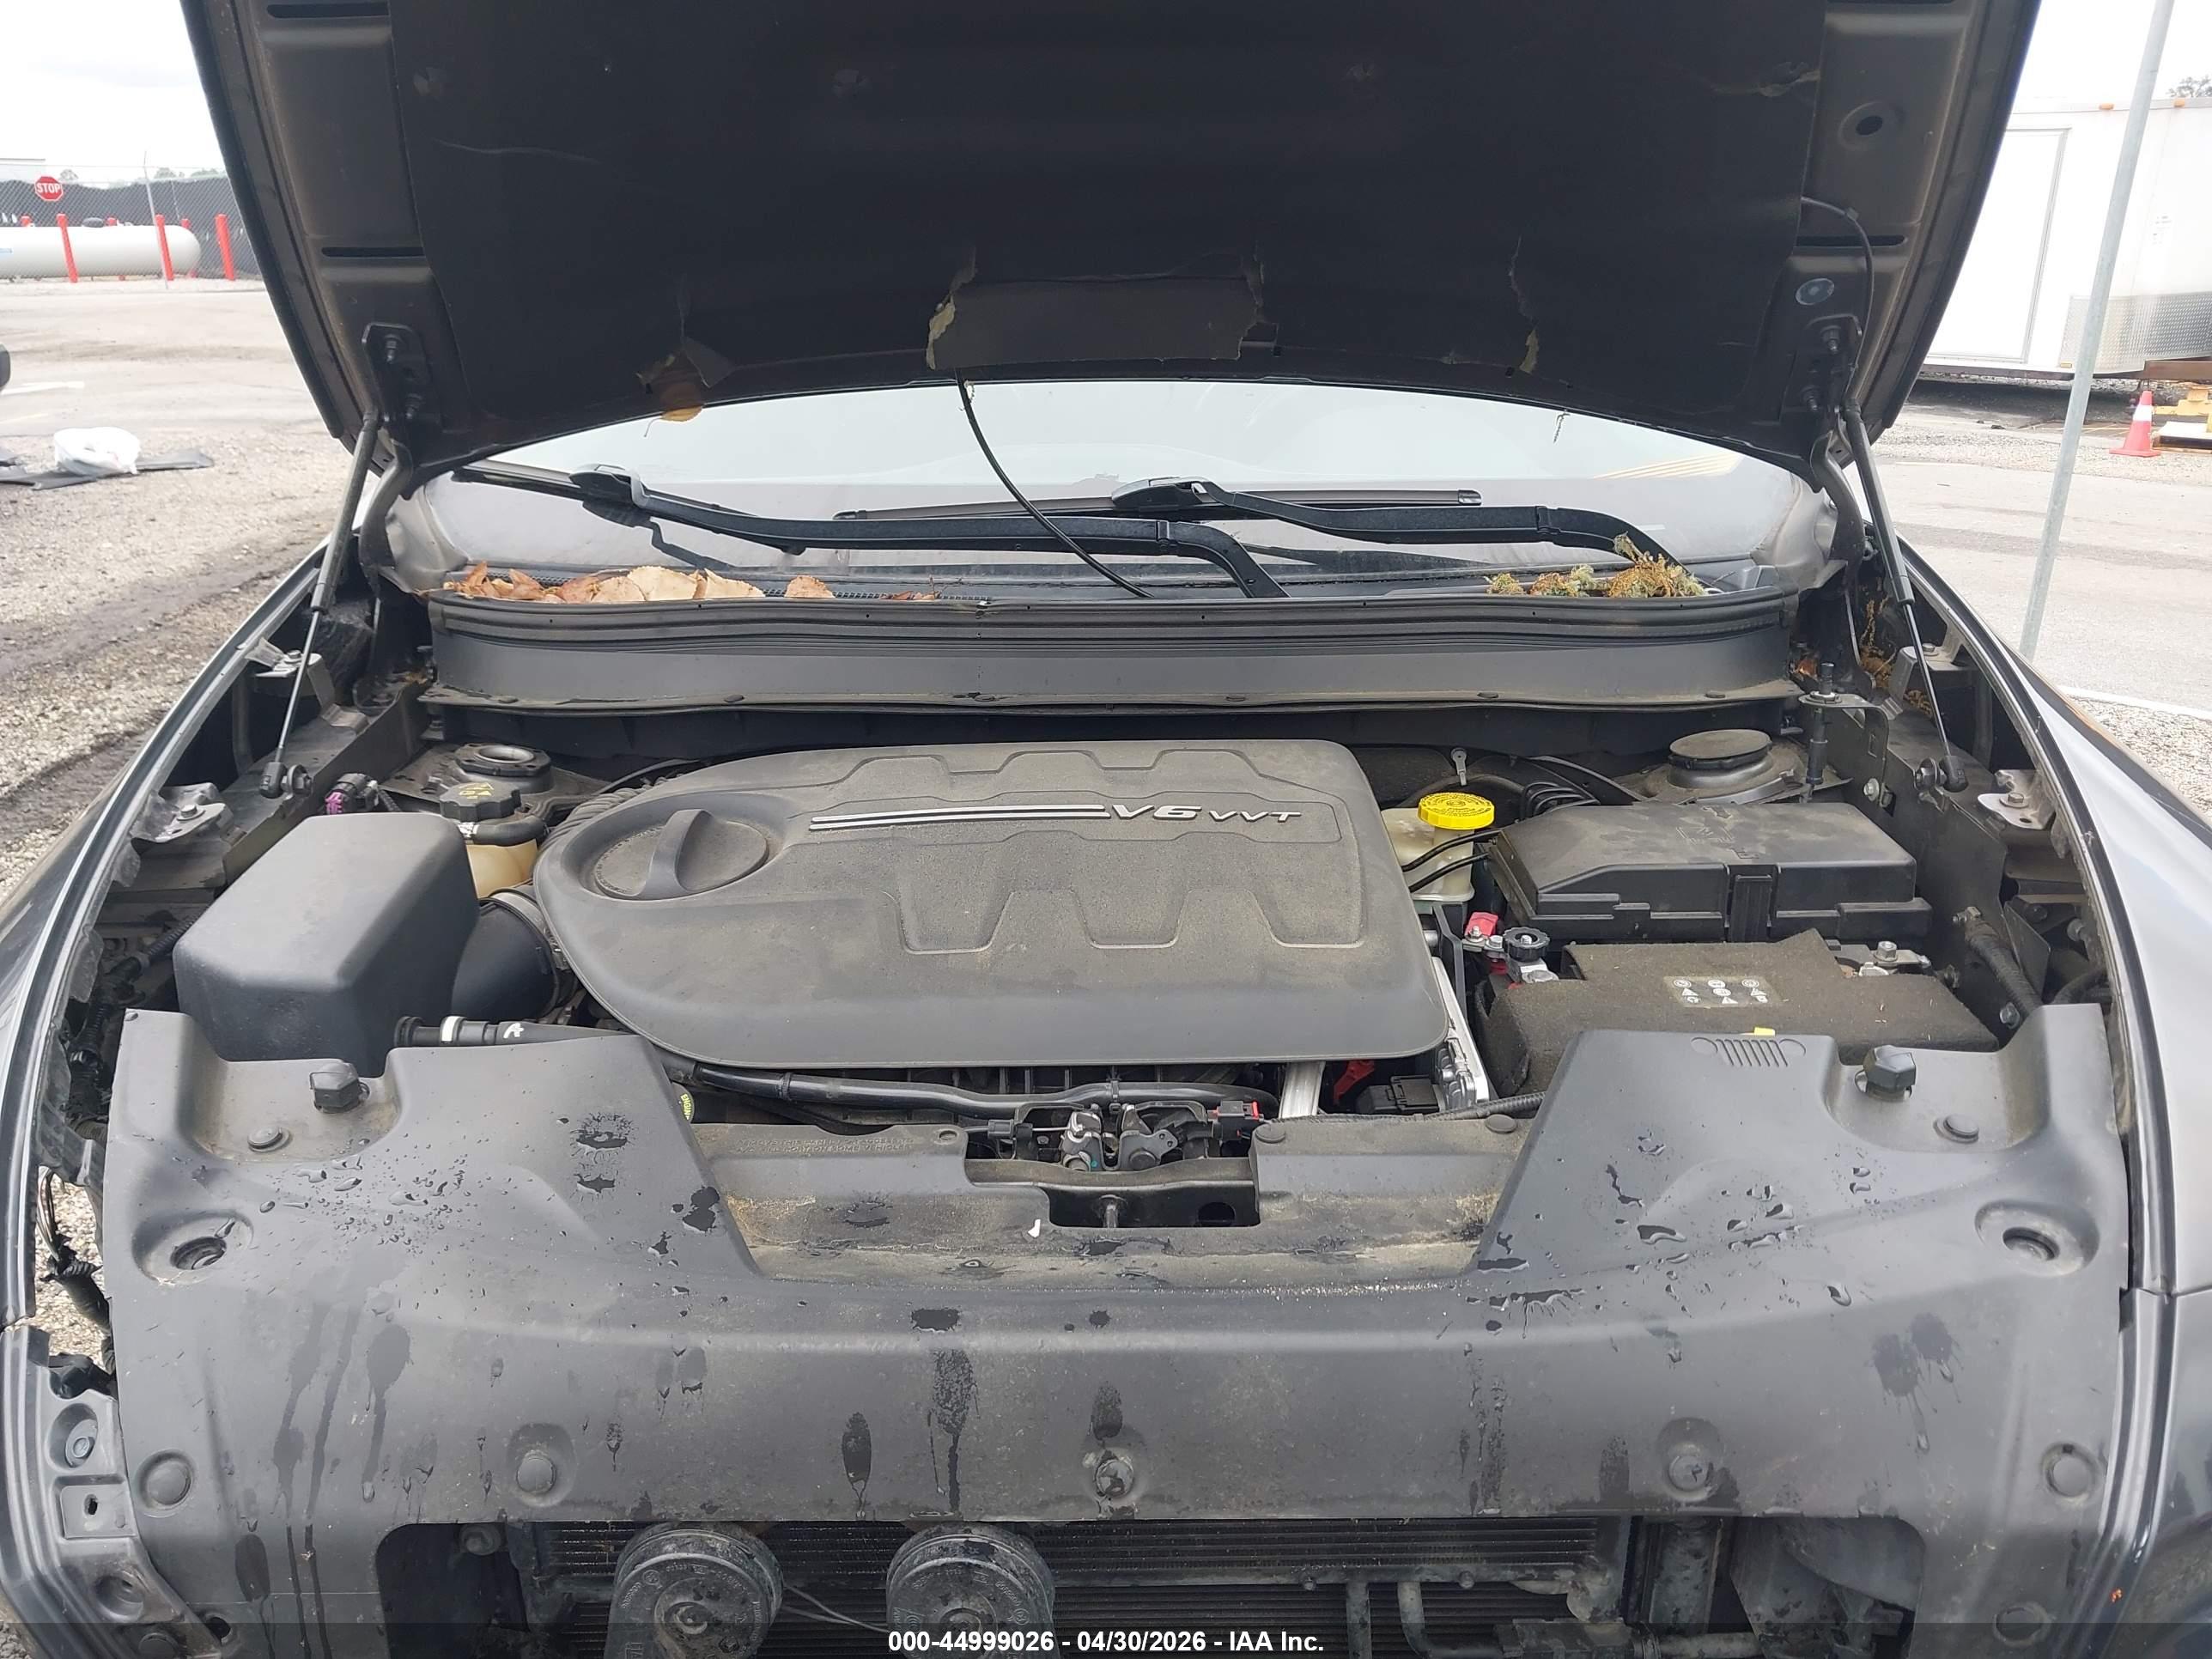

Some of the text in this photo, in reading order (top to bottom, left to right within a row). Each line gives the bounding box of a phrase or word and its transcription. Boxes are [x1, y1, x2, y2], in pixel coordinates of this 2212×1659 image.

[36, 182, 60, 193] STOP
[1112, 805, 1302, 823] V6 VVT
